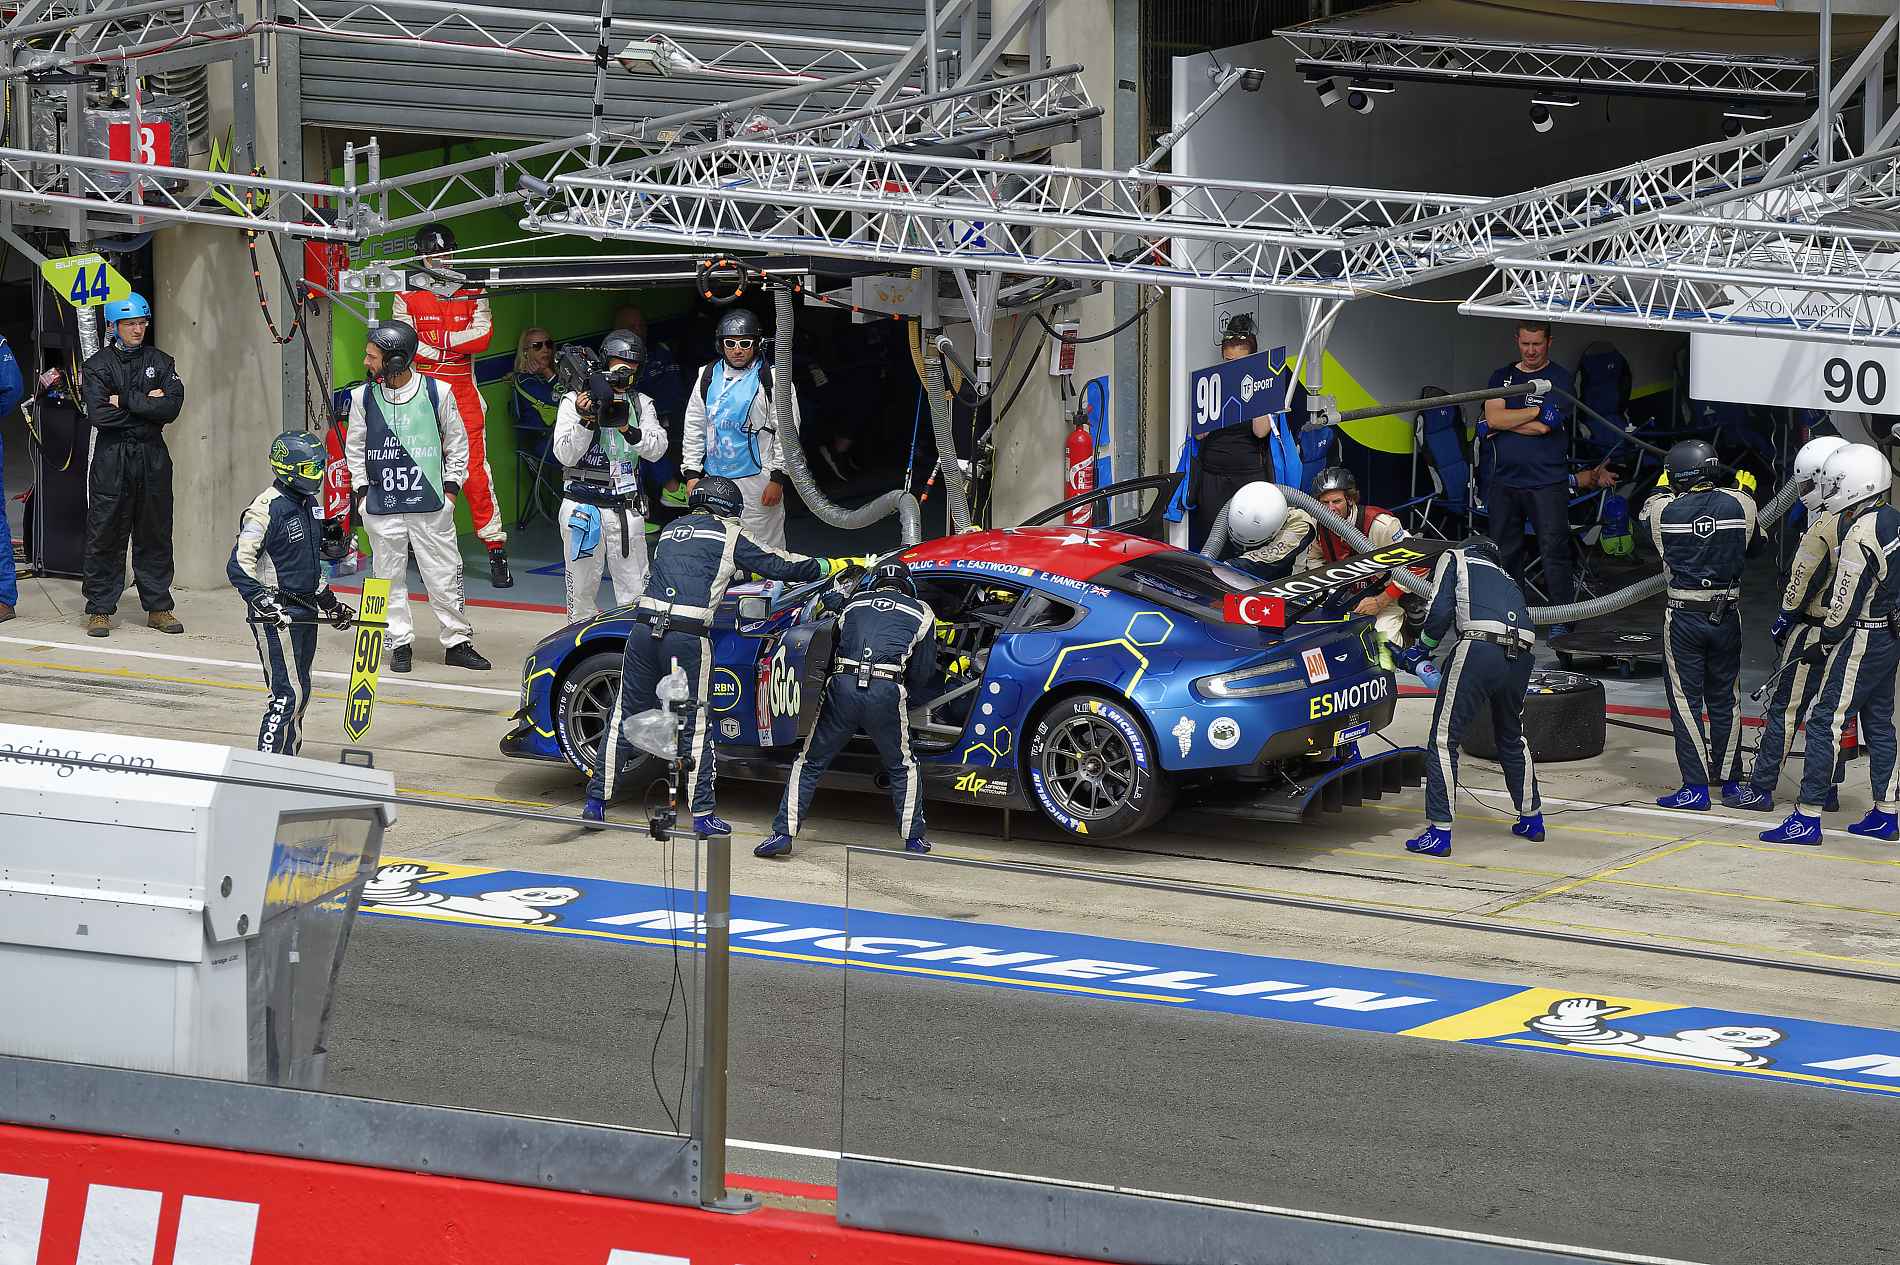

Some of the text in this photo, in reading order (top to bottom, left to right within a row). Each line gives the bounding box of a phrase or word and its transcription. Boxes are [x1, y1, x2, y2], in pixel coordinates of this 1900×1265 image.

[70, 264, 110, 305] 44
[1746, 300, 1853, 319] ASTON MARTIN
[1823, 357, 1887, 406] 90
[1196, 372, 1222, 425] 90
[1253, 377, 1274, 392] SPORT
[368, 448, 400, 460] PITLANE
[411, 446, 438, 458] TRACK
[382, 466, 423, 491] 852
[675, 528, 690, 538] TF
[1696, 521, 1713, 533] TF
[967, 560, 1019, 575] EASTWOOD
[1050, 575, 1089, 591] HANKEY
[1259, 547, 1426, 600] ESMOTOR
[365, 595, 385, 615] STOP
[876, 600, 891, 608] TF
[1833, 571, 1852, 609] SPORT
[356, 629, 382, 673] 90
[1307, 653, 1328, 677] AM
[714, 683, 735, 692] RBN
[1309, 676, 1388, 720] ESMOTOR
[353, 699, 370, 721] TF
[261, 712, 281, 753] SPOR
[723, 723, 737, 732] TF
[1107, 710, 1145, 763] MICHELIN
[559, 722, 582, 767] MICHELIN
[978, 788, 1007, 796] PHOTOGRAPHY
[1032, 773, 1068, 824] MICHELIN
[586, 908, 1439, 1012] MICHELIN
